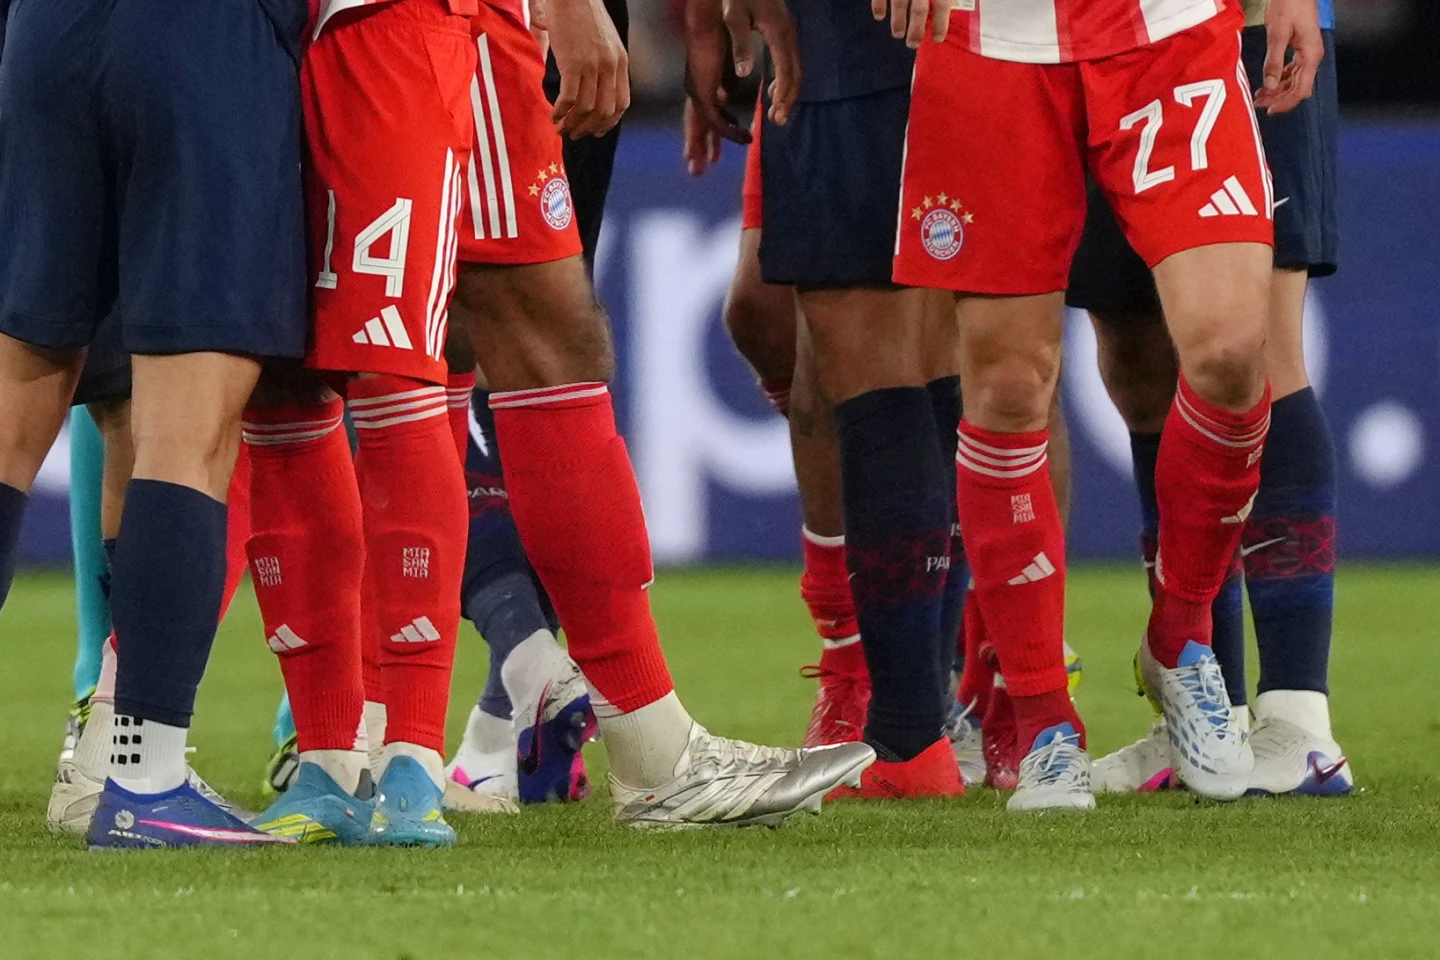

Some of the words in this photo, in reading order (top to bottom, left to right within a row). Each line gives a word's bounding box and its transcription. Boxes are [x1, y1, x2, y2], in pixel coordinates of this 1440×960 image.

[1119, 78, 1228, 195] 27
[315, 189, 413, 298] 14
[403, 547, 430, 558] MIA
[255, 557, 279, 567] MIA
[403, 557, 430, 568] SAN
[258, 566, 281, 576] SAN
[403, 568, 428, 578] MIA
[260, 575, 282, 587] MIA
